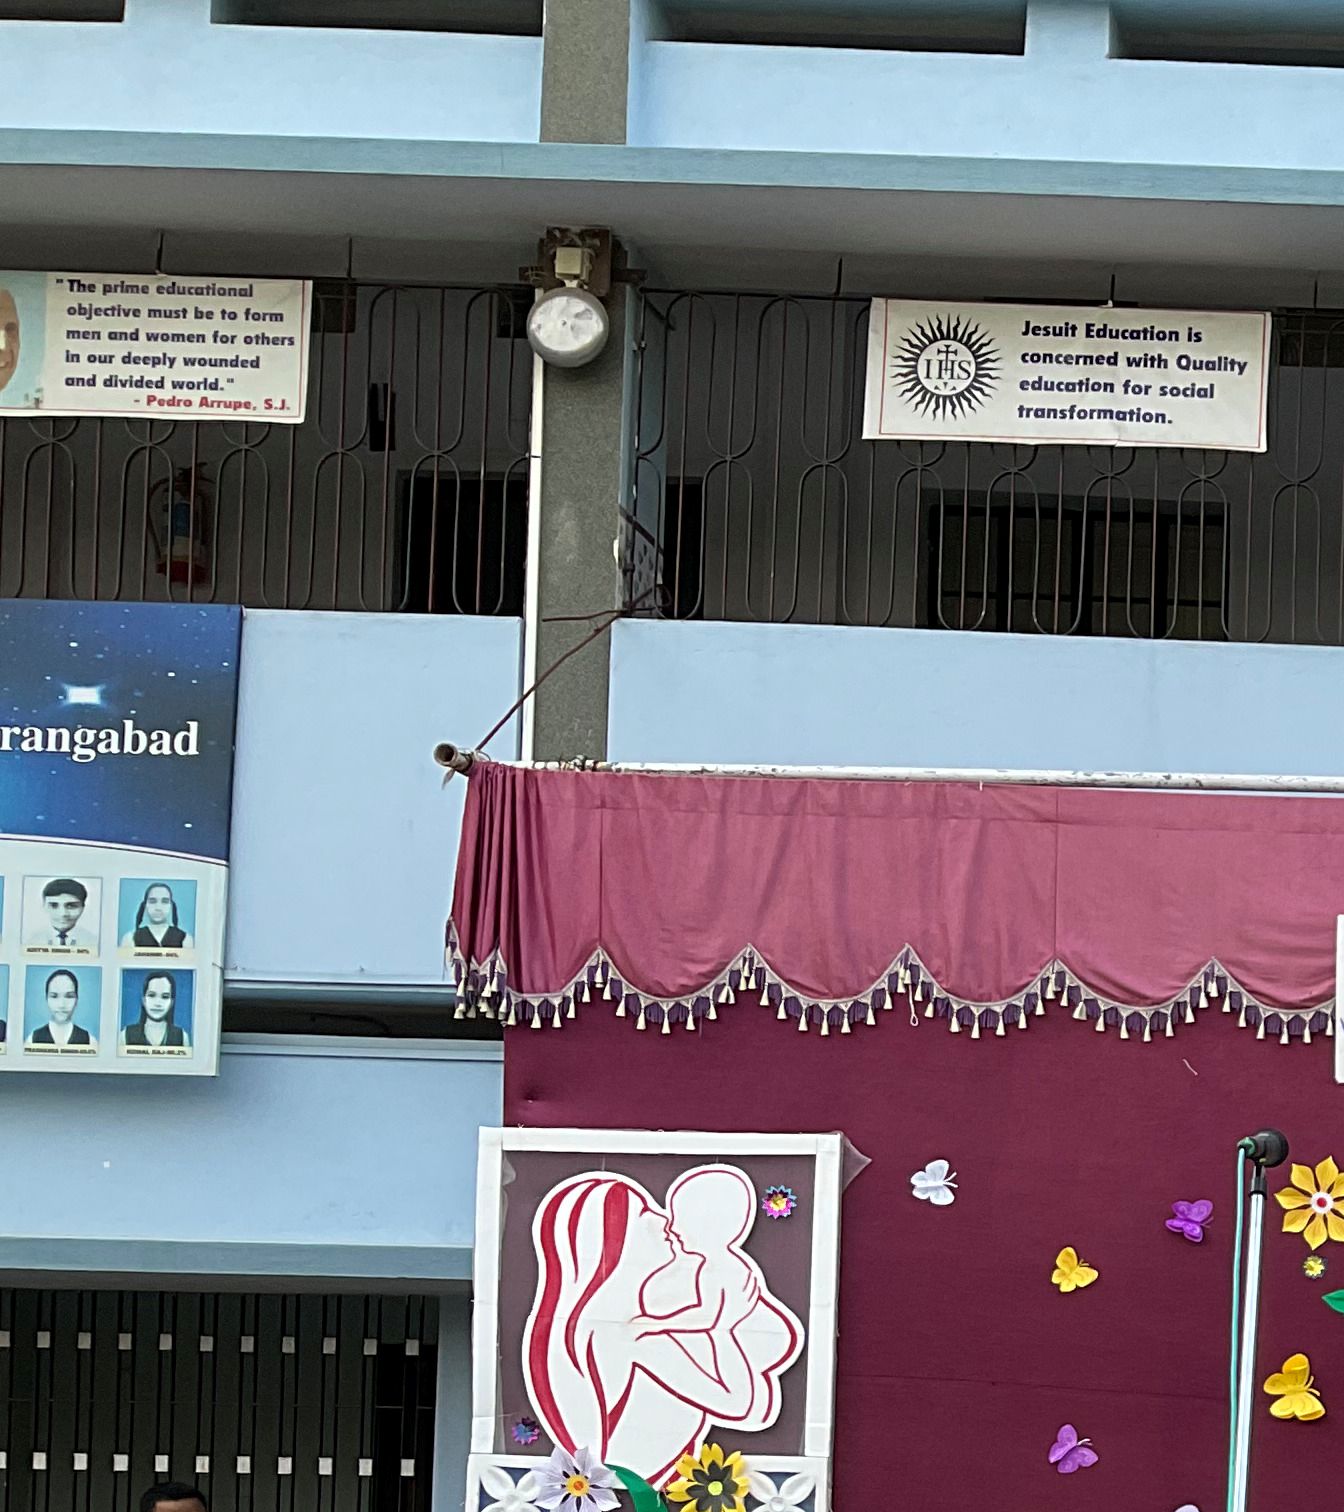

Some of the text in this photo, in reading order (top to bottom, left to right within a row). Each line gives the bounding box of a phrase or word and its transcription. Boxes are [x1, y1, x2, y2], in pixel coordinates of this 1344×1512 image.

[102, 281, 149, 295] prime
[156, 282, 253, 297] educational
[67, 303, 284, 322] objective must be to form
[66, 328, 295, 346] men and women for others
[1021, 320, 1202, 343] Jesuit Education is
[65, 350, 260, 369] in our deeply wounded
[1020, 351, 1248, 376] concerned with Quality
[65, 375, 96, 387] and
[103, 376, 165, 389] divided
[1019, 375, 1215, 399] education for social
[146, 395, 193, 407] Pedro
[264, 399, 290, 410] S.J.
[1018, 403, 1173, 424] transformation.
